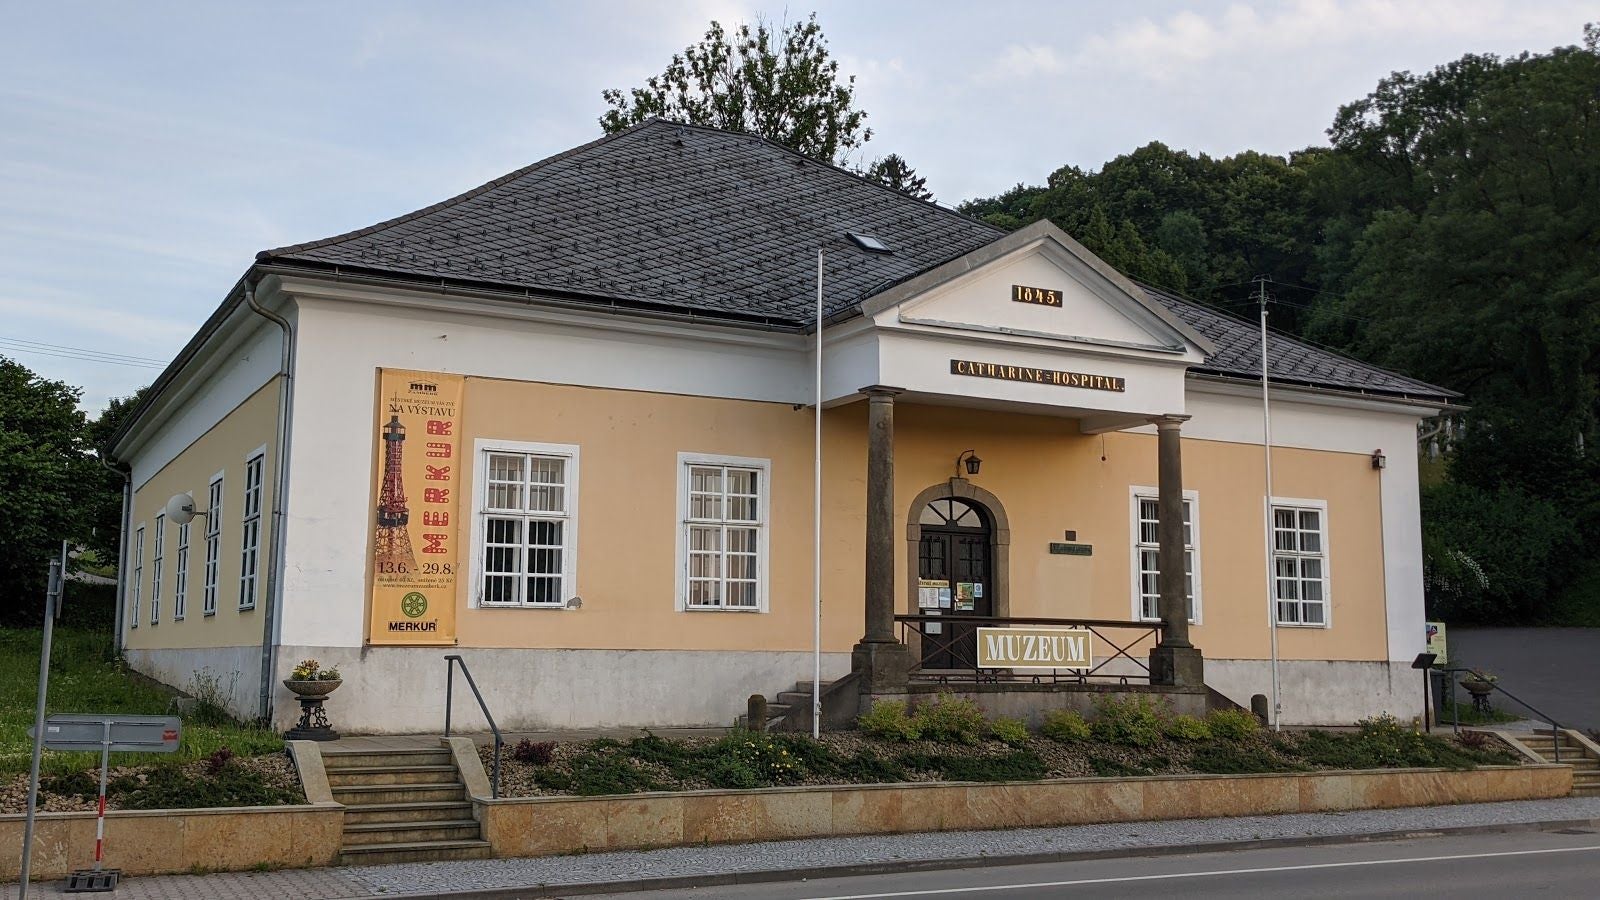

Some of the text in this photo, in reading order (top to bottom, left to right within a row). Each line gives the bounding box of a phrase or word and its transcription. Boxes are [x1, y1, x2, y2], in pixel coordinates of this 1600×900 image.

[1016, 285, 1060, 304] 1845.
[389, 403, 456, 417] NA VÝSTAVU
[422, 420, 453, 554] MERKUR
[379, 561, 410, 574] 13.6.
[422, 562, 454, 575] 29.8.
[389, 622, 436, 631] MERKUR
[985, 634, 1086, 662] MUZEUM
